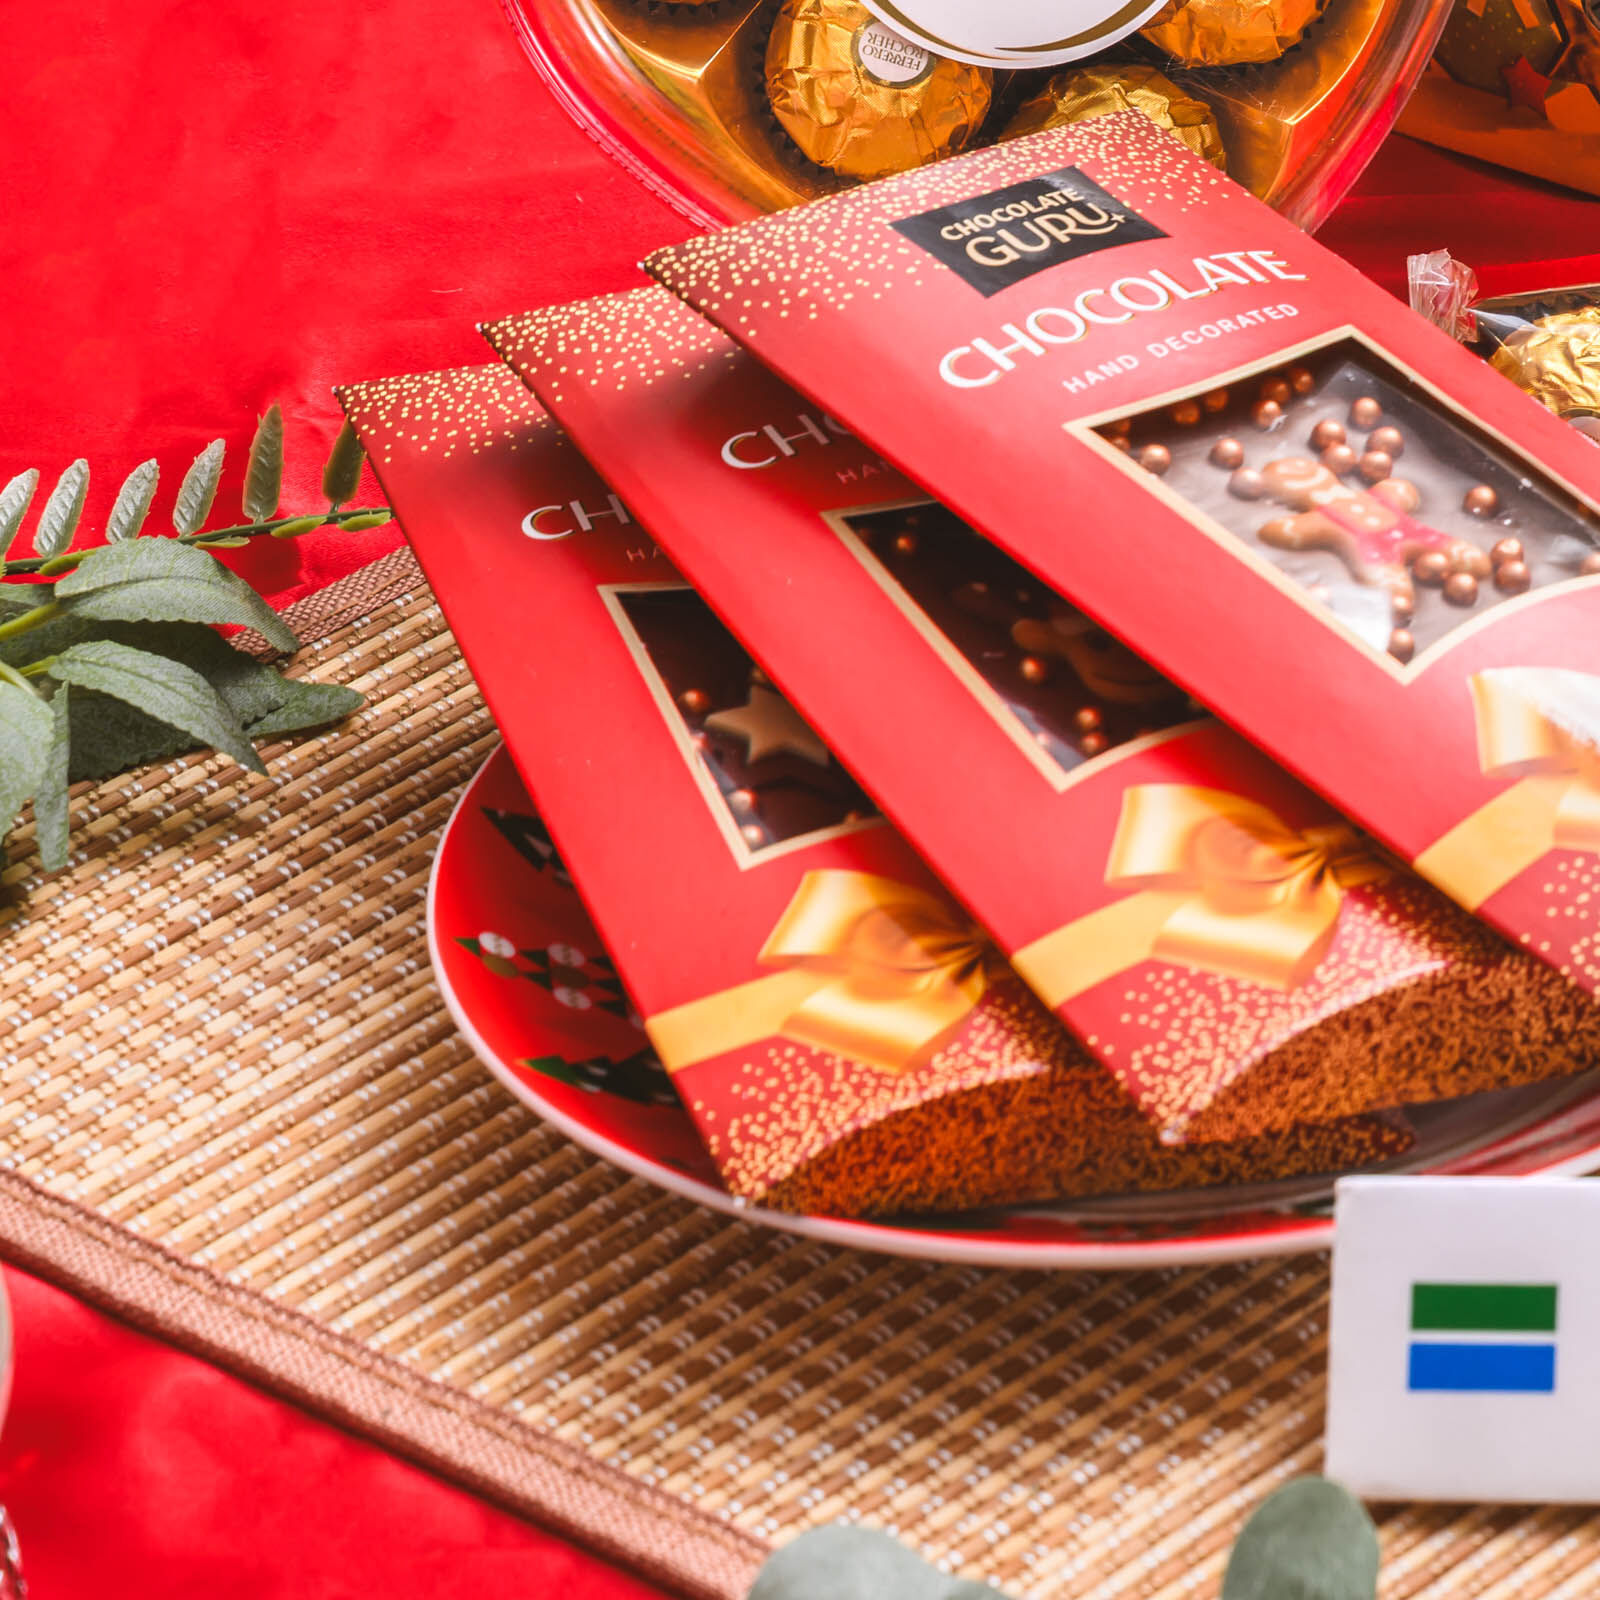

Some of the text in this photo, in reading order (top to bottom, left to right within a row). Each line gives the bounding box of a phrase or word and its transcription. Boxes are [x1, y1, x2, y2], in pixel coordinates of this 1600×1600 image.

[862, 44, 922, 71] FERRERO
[940, 187, 1085, 242] CHOCOLATE
[964, 201, 1112, 268] GURU
[938, 249, 1308, 389] CHOCOLATE
[1062, 302, 1300, 395] HAND DECORATED
